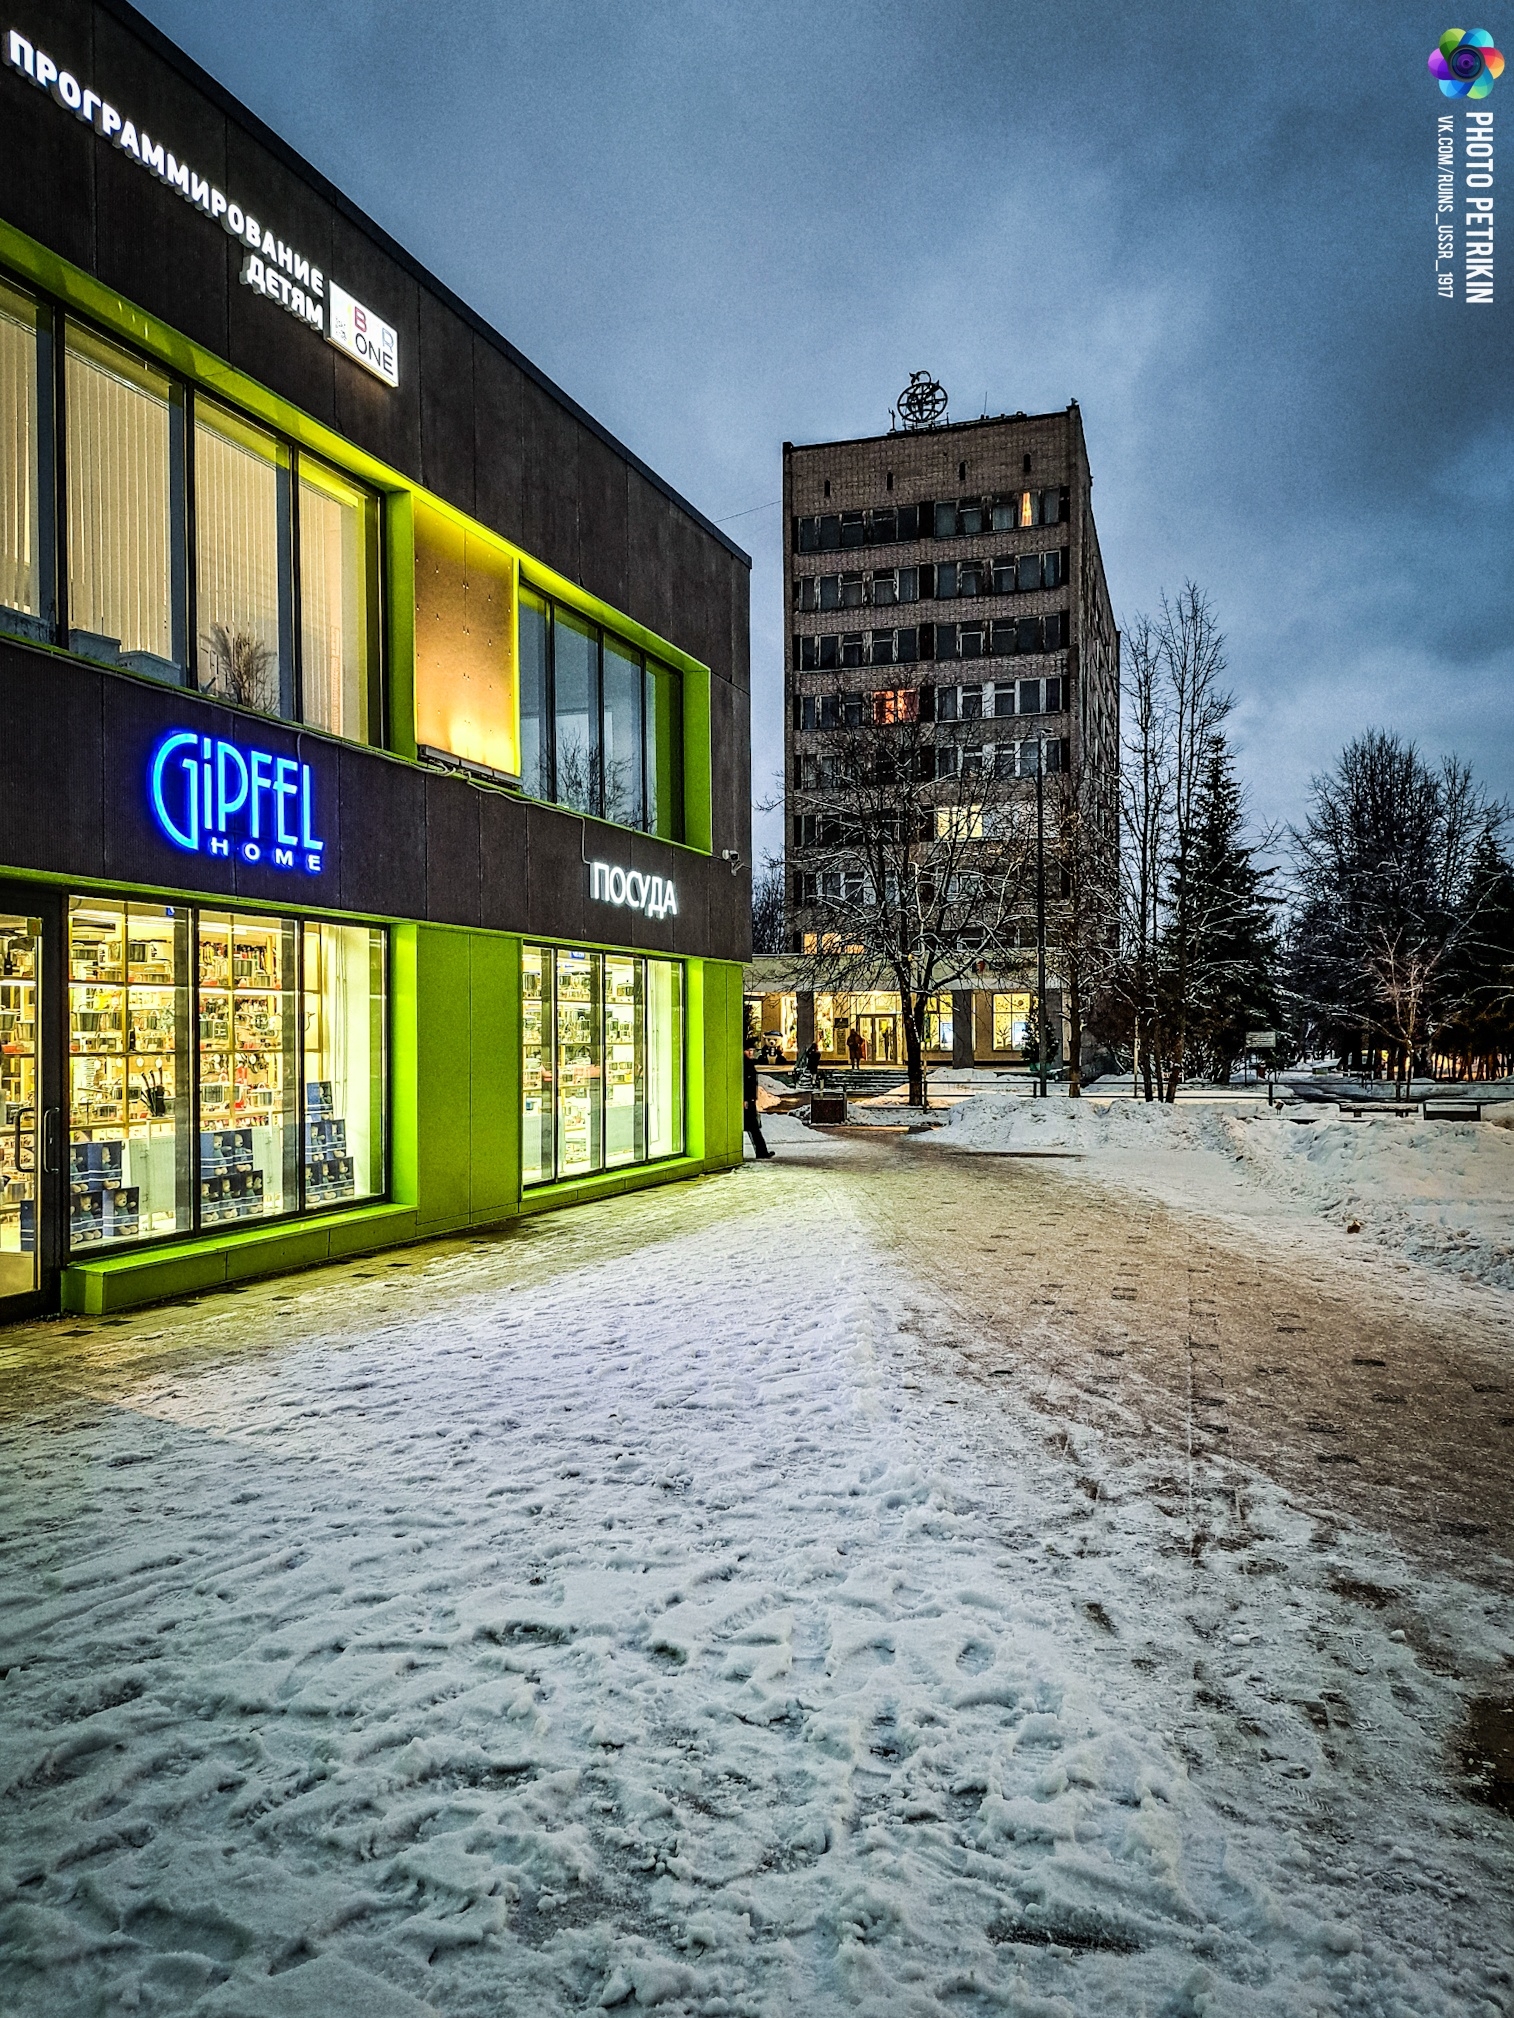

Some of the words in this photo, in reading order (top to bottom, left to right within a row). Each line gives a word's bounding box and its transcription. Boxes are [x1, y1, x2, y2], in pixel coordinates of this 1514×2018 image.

[9, 29, 325, 296] ПРОГРАММИРОВАНИЕ
[246, 253, 324, 330] ДЕТЯМ
[355, 332, 394, 376] ONE
[210, 836, 322, 872] HOME
[591, 860, 678, 920] ПОСУДА
